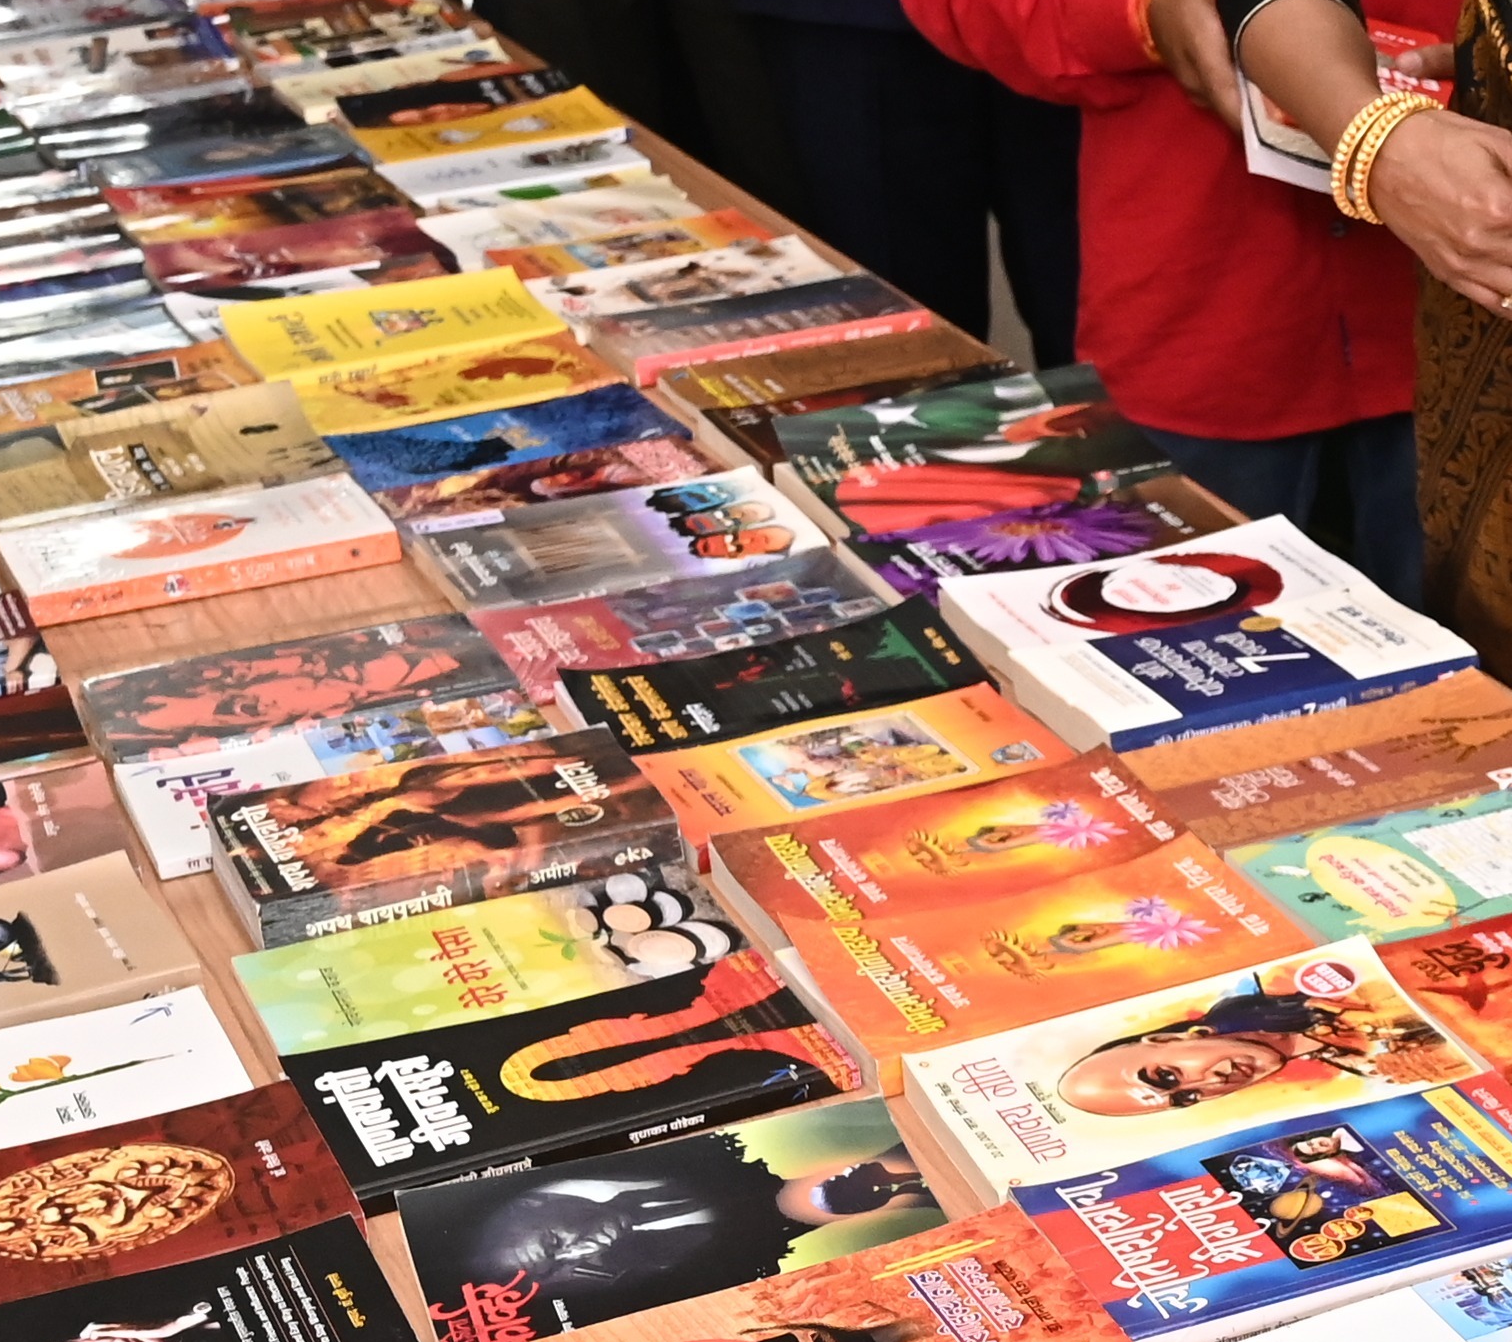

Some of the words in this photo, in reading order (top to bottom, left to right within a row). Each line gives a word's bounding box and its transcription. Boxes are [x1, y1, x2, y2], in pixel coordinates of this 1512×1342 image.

[612, 842, 655, 868] eka
[430, 926, 476, 962] पैसा
[1304, 970, 1337, 996] BEST
[1312, 962, 1354, 993] SELLER
[952, 1057, 1017, 1101] नीति
[375, 1056, 471, 1151] जीवनसूत्रे
[996, 1103, 1067, 1163] चाणक्य
